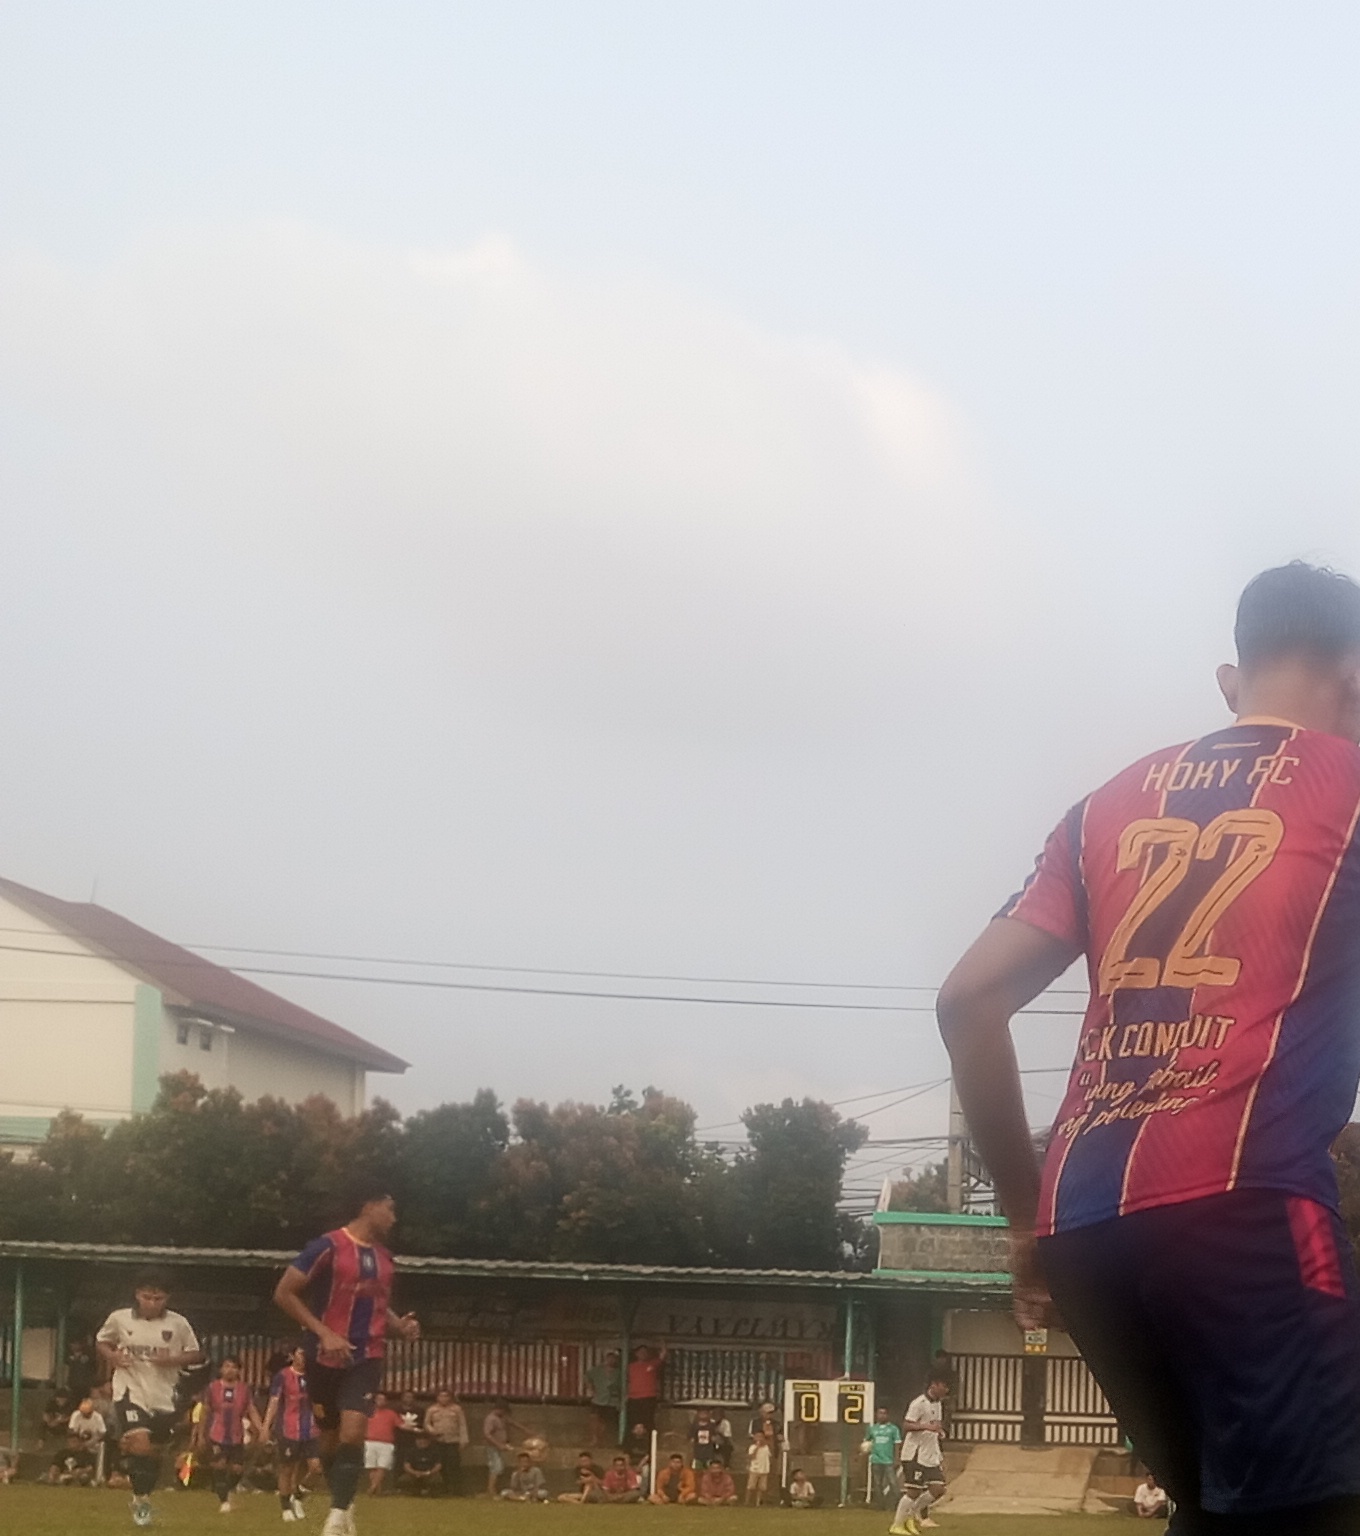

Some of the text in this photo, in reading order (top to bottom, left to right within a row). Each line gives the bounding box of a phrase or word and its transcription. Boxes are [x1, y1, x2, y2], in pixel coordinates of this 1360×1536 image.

[1141, 753, 1300, 793] HOKY FC
[1099, 808, 1285, 997] 22
[1118, 1012, 1237, 1059] CONDUIT
[801, 1393, 862, 1424] 0 2
